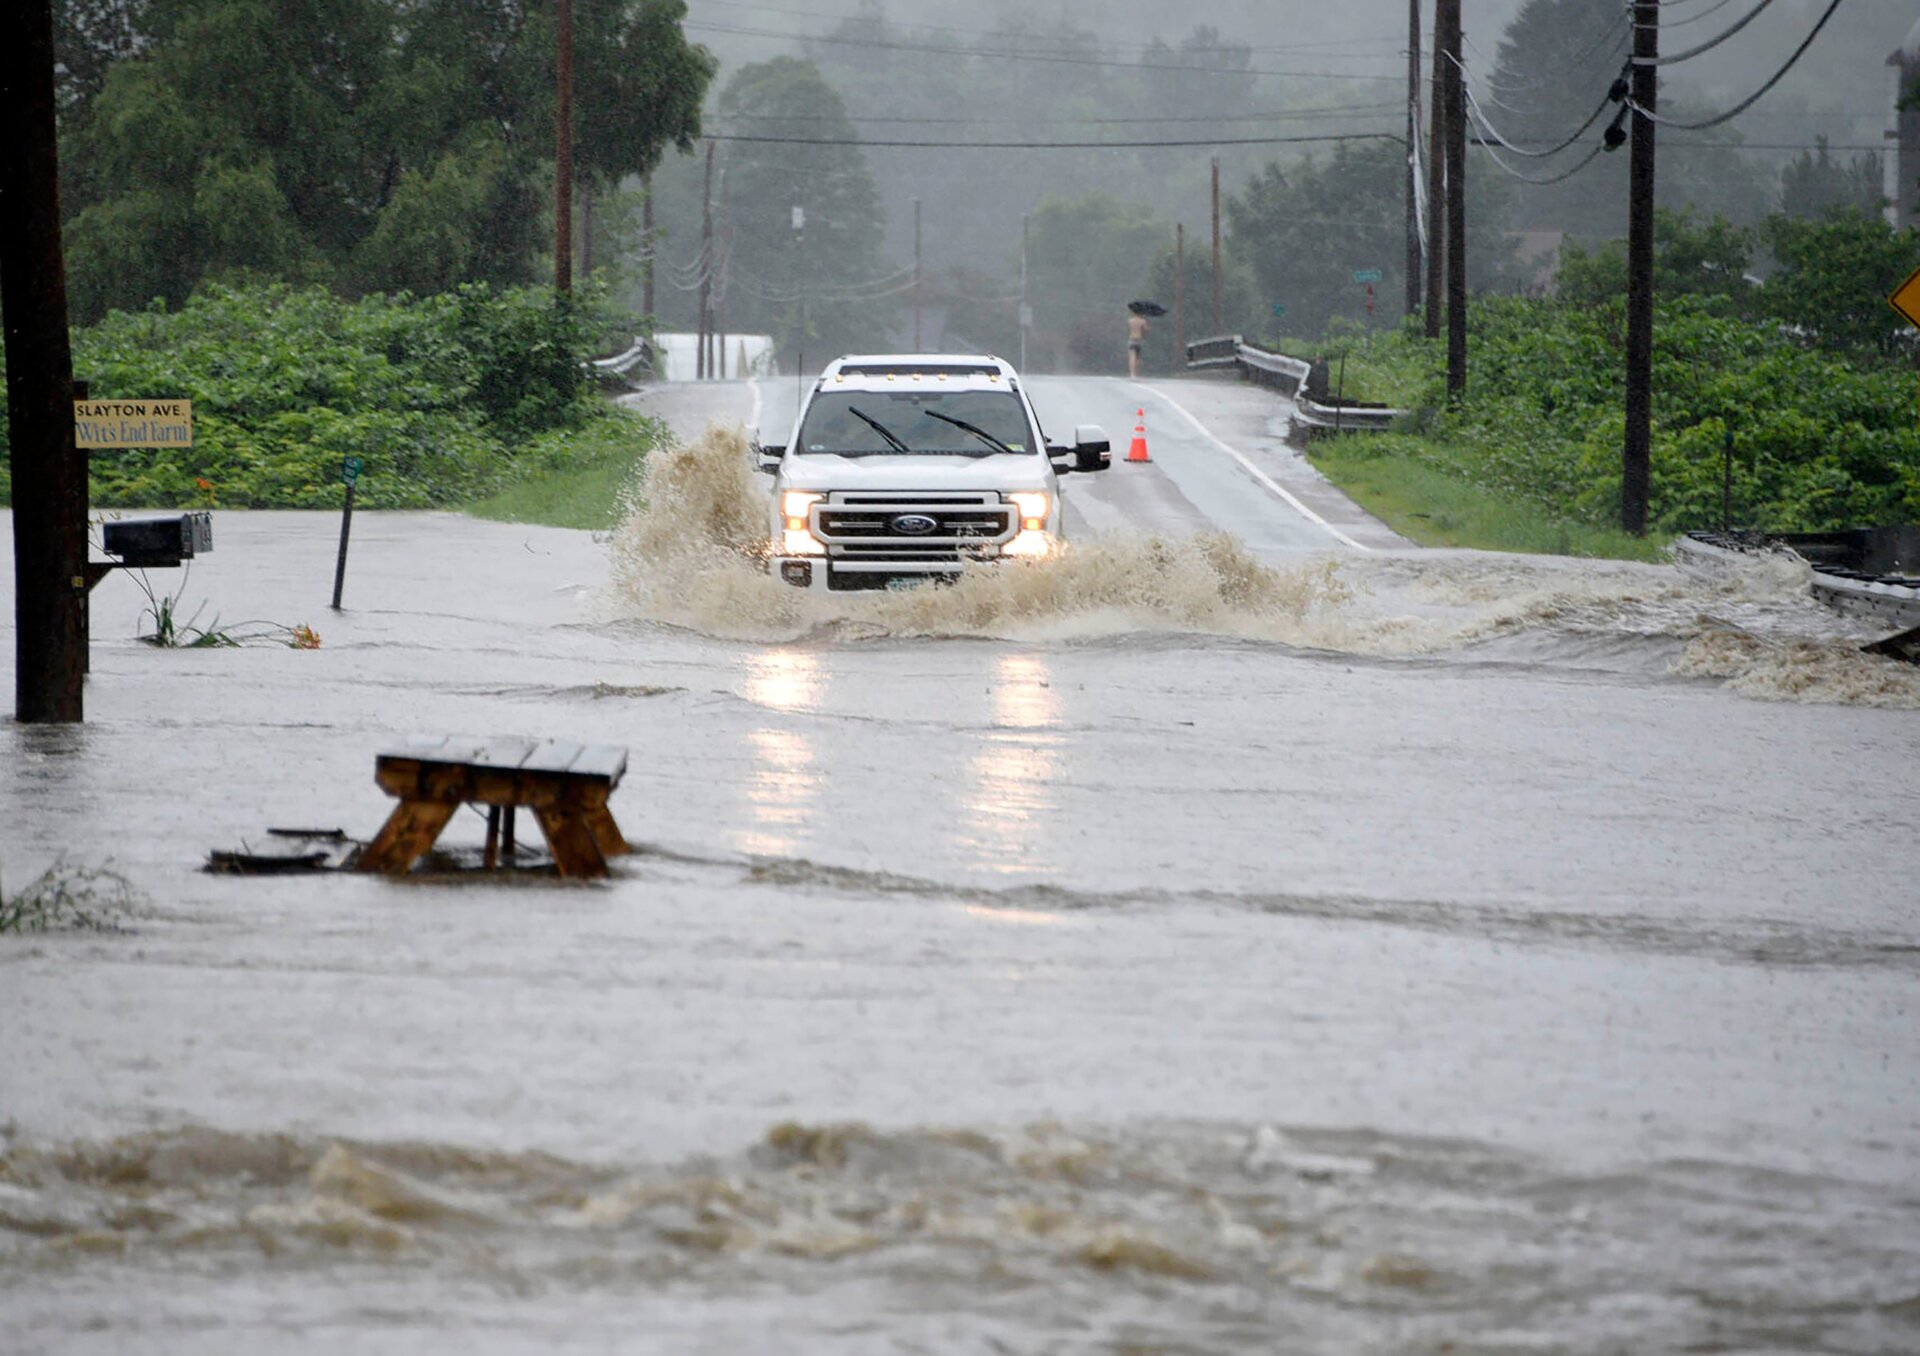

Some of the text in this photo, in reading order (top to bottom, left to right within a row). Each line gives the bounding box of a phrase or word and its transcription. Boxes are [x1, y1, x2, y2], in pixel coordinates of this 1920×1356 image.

[77, 404, 186, 417] SLAYTON AVE.
[121, 420, 147, 442] End
[150, 420, 188, 442] Farm
